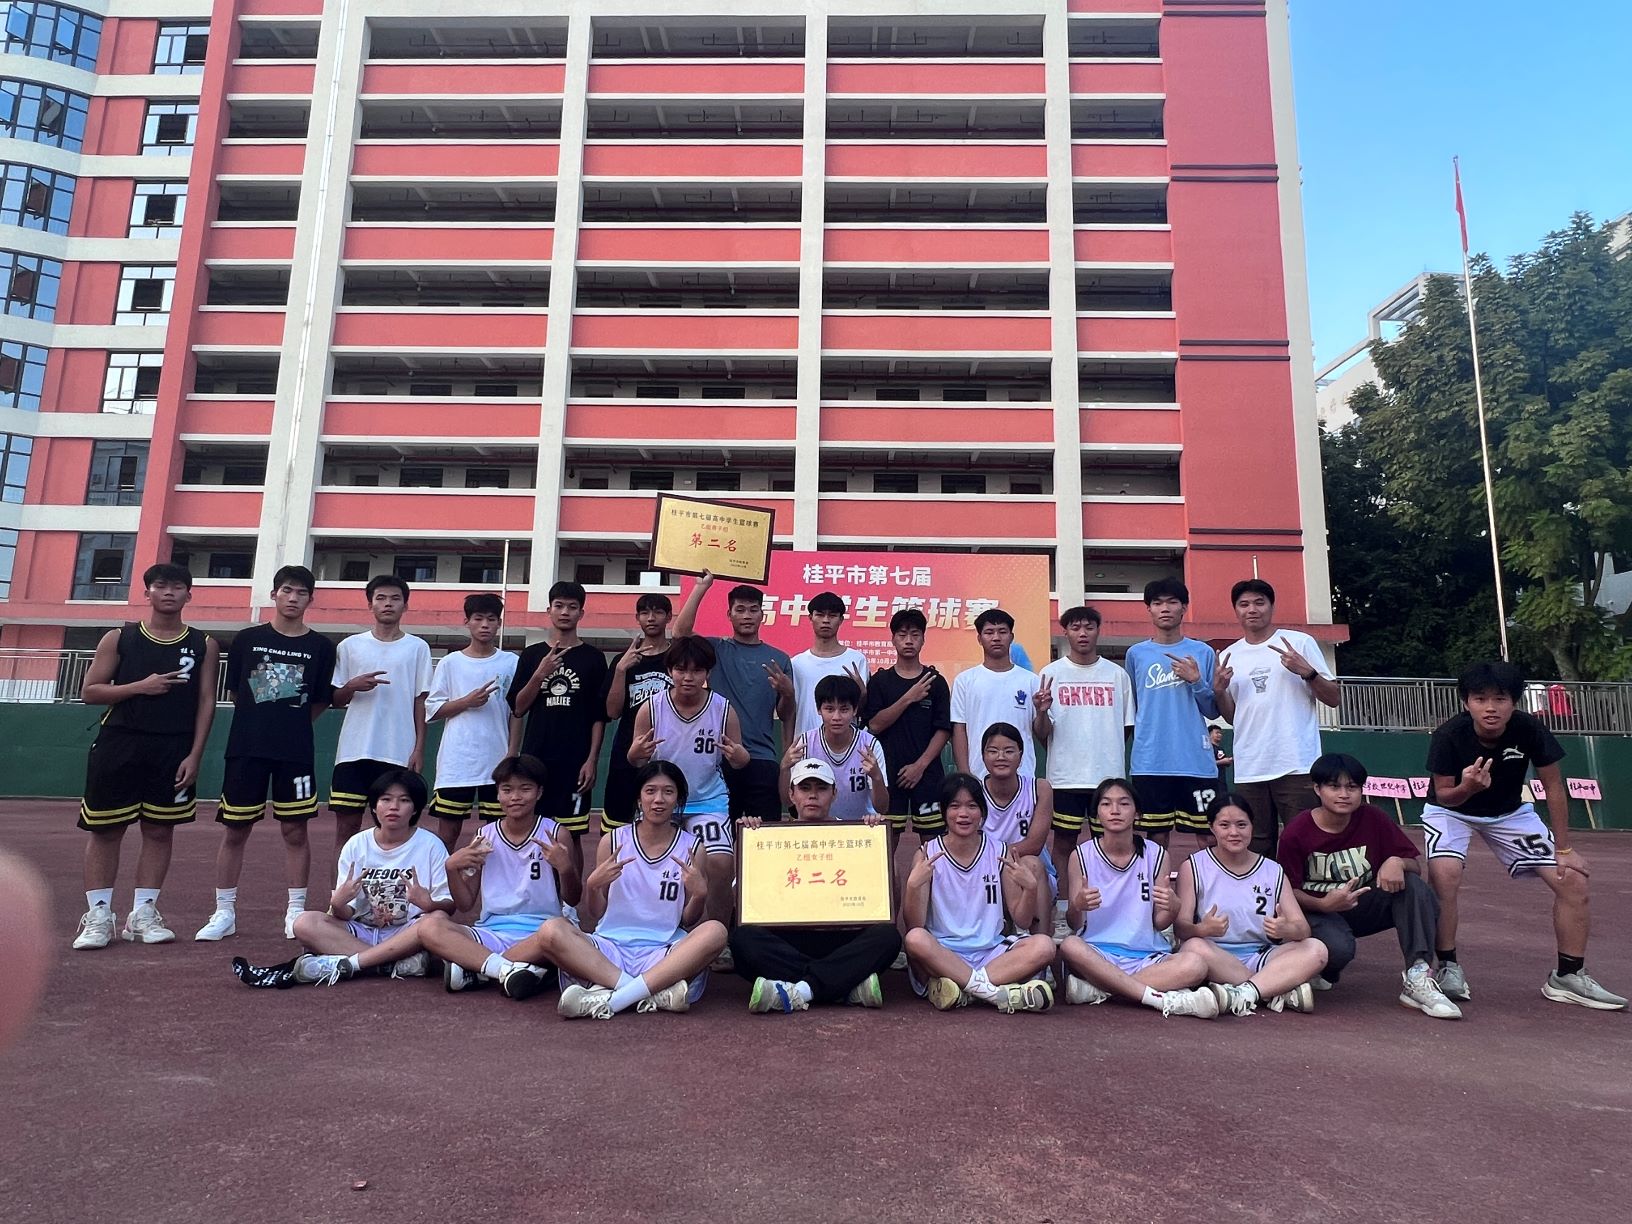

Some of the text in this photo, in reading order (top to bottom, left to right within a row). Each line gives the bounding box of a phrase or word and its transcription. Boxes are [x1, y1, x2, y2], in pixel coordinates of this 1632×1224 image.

[689, 532, 737, 552] 第二名
[802, 564, 931, 586] 桂平市第七届
[177, 656, 195, 679] 2
[693, 737, 716, 754] 30
[293, 775, 311, 800] 11
[849, 776, 866, 793] 13
[572, 793, 582, 815] 7
[1020, 820, 1029, 837] 8
[756, 839, 872, 850] 桂平市第七届高中学生篮球赛
[530, 861, 541, 881] 9
[785, 867, 848, 889] 第二名
[659, 880, 679, 902] 10
[985, 884, 998, 905] 11
[1141, 882, 1150, 902] 5
[1255, 895, 1268, 916] 2
